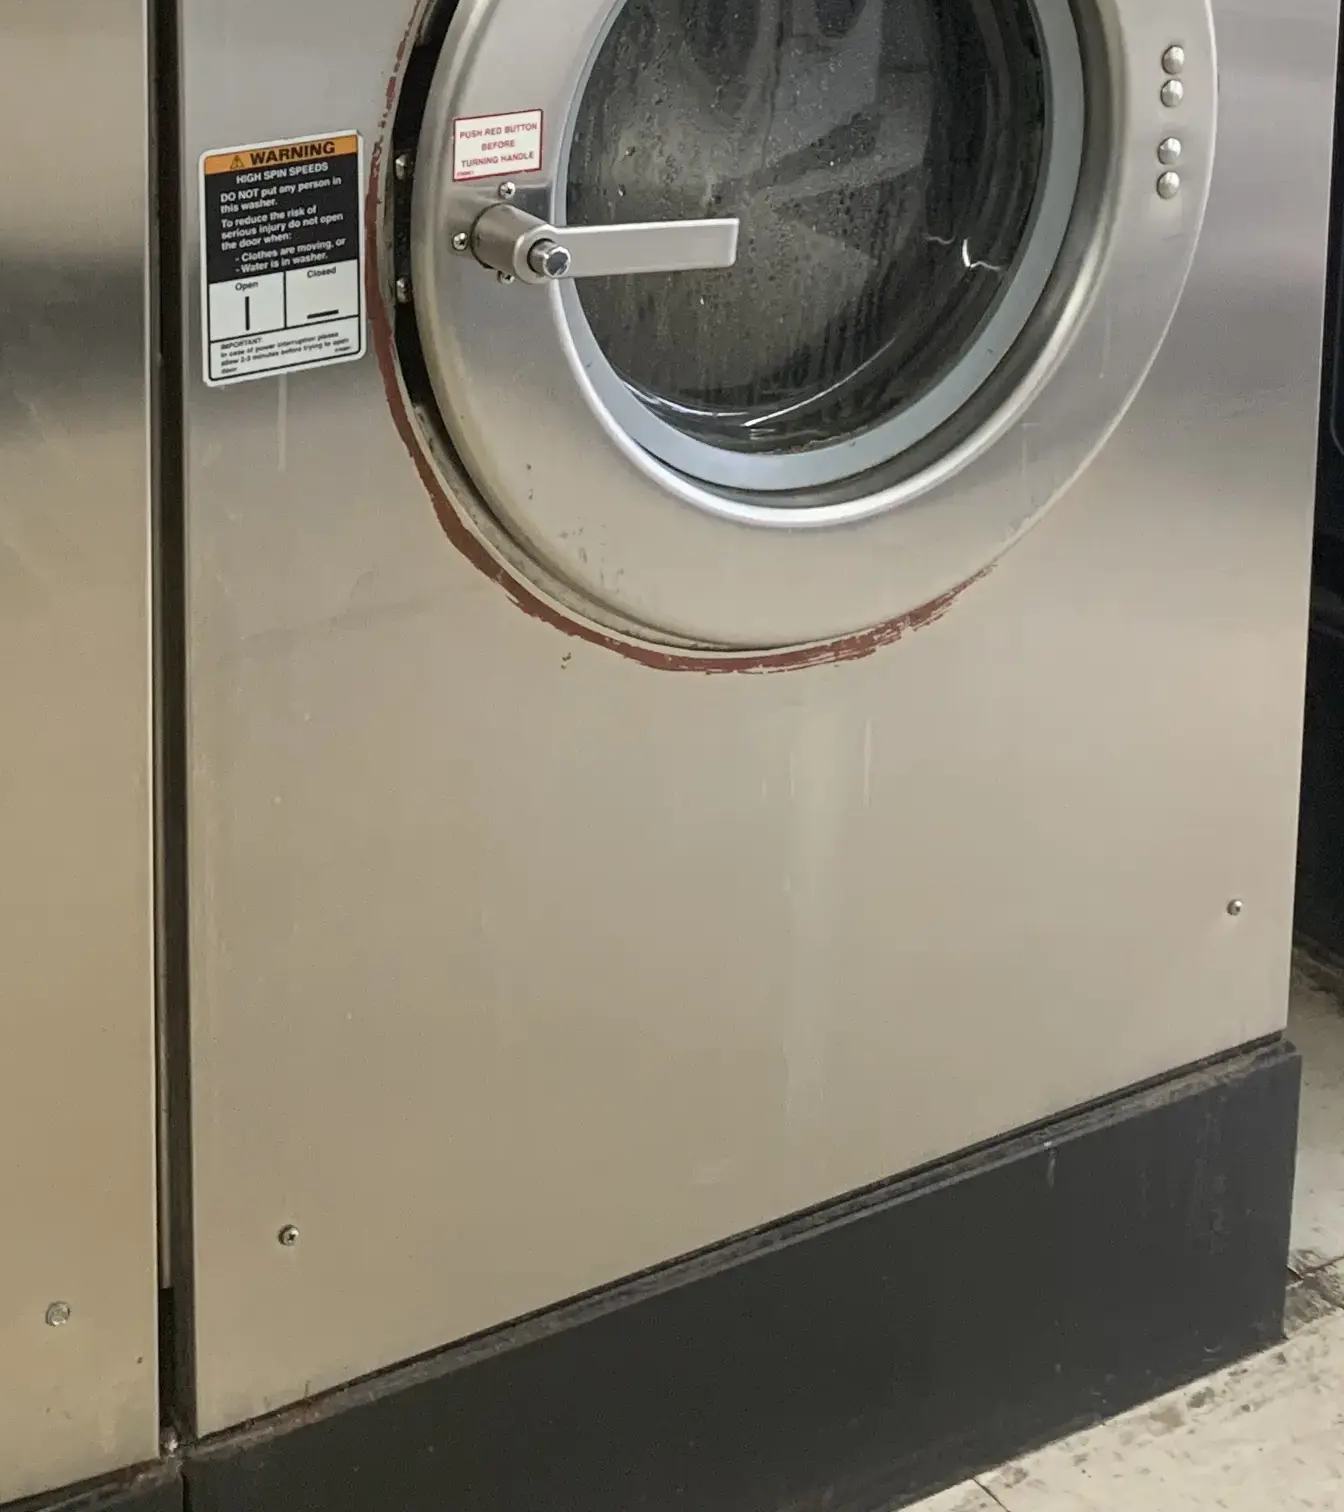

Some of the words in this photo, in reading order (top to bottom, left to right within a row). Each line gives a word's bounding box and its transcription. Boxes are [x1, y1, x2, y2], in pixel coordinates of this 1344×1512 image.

[460, 129, 482, 139] PUSH
[484, 127, 502, 136] RED
[504, 122, 538, 134] BUTTON
[250, 141, 335, 165] WARNING
[481, 139, 515, 151] BEFORE
[461, 156, 499, 168] TURNING
[501, 151, 534, 163] HANDLE
[236, 171, 262, 184] HIGH
[264, 167, 287, 180] SPIN
[289, 162, 328, 176] SPEEDS
[221, 192, 236, 203] DO
[238, 188, 259, 200] NOT
[261, 187, 277, 199] put
[279, 183, 296, 194] any
[298, 178, 330, 191] person
[333, 177, 342, 185] in
[221, 203, 239, 214] this
[241, 198, 278, 210] washer.
[221, 218, 233, 229] To
[235, 214, 268, 226] reduce
[270, 210, 285, 221] the
[287, 207, 305, 218] risk
[307, 204, 317, 215] of
[221, 228, 257, 239] serious
[259, 222, 287, 235] injury
[288, 218, 301, 229] do
[302, 216, 318, 226] not
[320, 213, 344, 225] open
[221, 241, 237, 251] the
[239, 236, 261, 247] door
[264, 232, 292, 243] when:
[241, 249, 278, 263] Clothes
[280, 246, 296, 255] are
[335, 238, 347, 247] or
[241, 262, 269, 274] Water
[270, 259, 279, 268] is
[281, 257, 291, 266] in
[292, 251, 328, 265] washer.
[307, 267, 337, 278] Closed
[235, 281, 259, 292] Open
